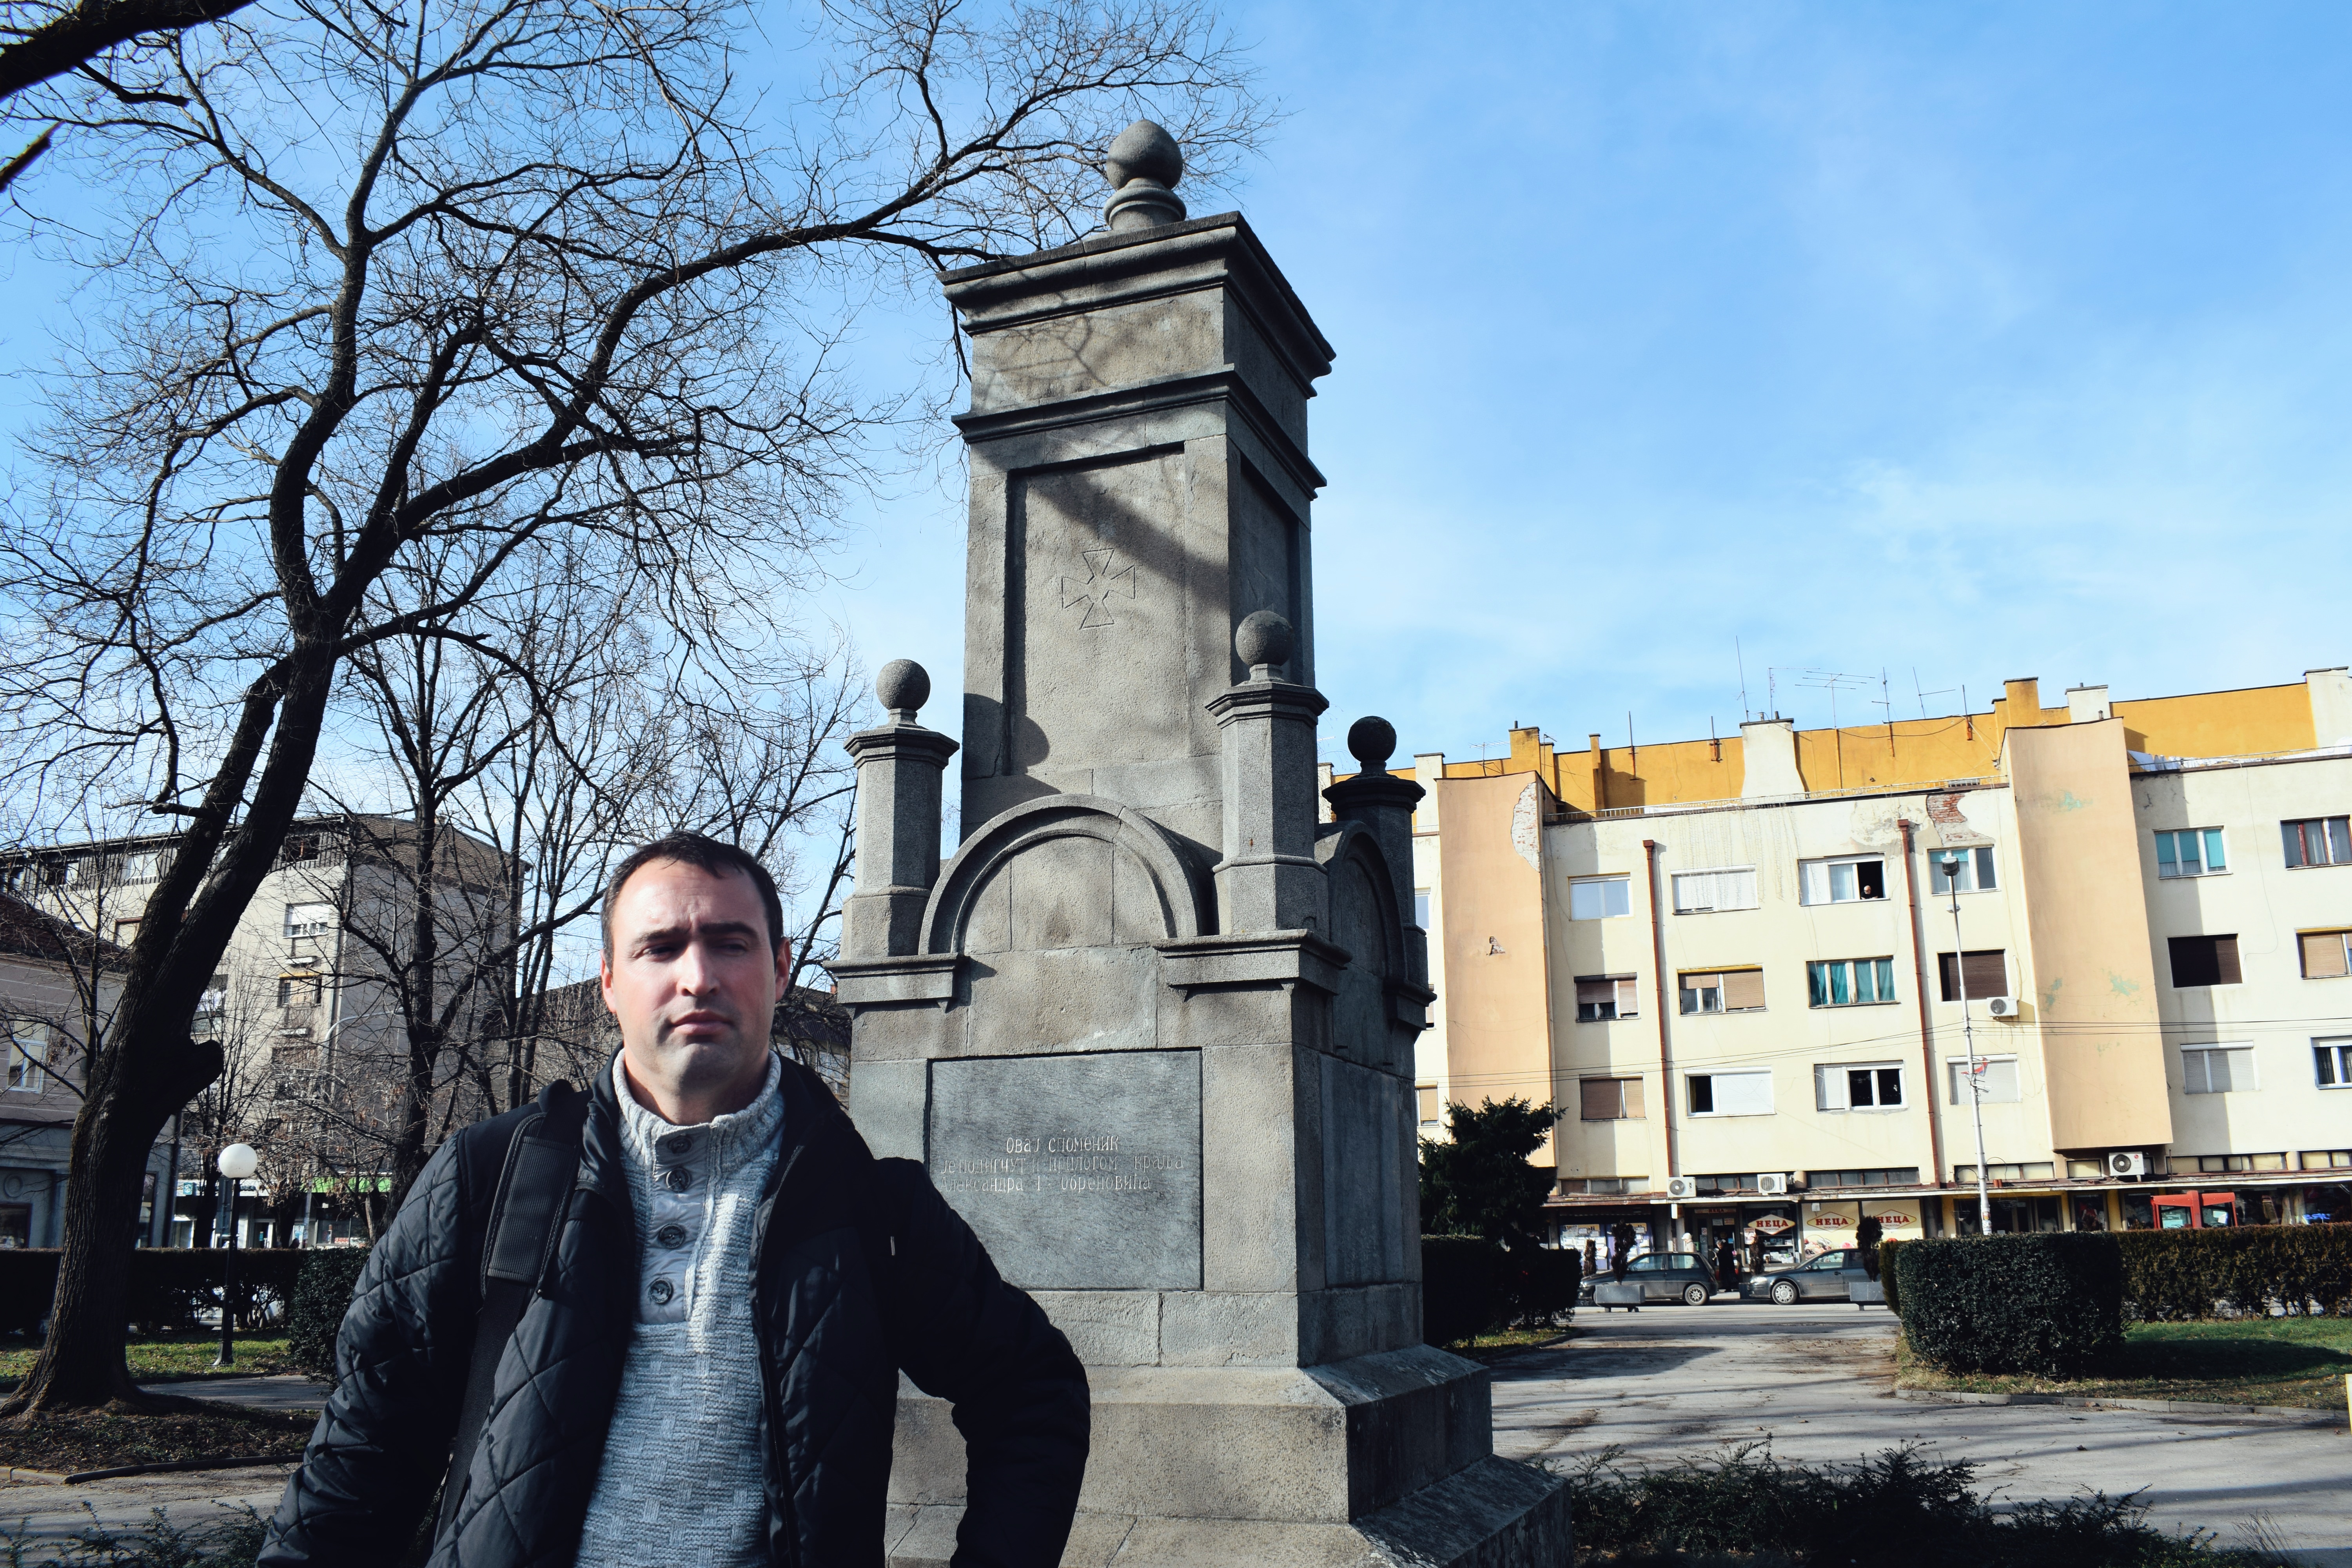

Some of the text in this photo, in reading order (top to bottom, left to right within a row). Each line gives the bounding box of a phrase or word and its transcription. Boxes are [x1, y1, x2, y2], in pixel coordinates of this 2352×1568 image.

[1006, 1136, 1118, 1153] Овај споменик
[940, 1176, 1024, 1193] Александра
[1816, 1218, 1849, 1226] НЕЦА
[1876, 1216, 1910, 1224] НЕЦА
